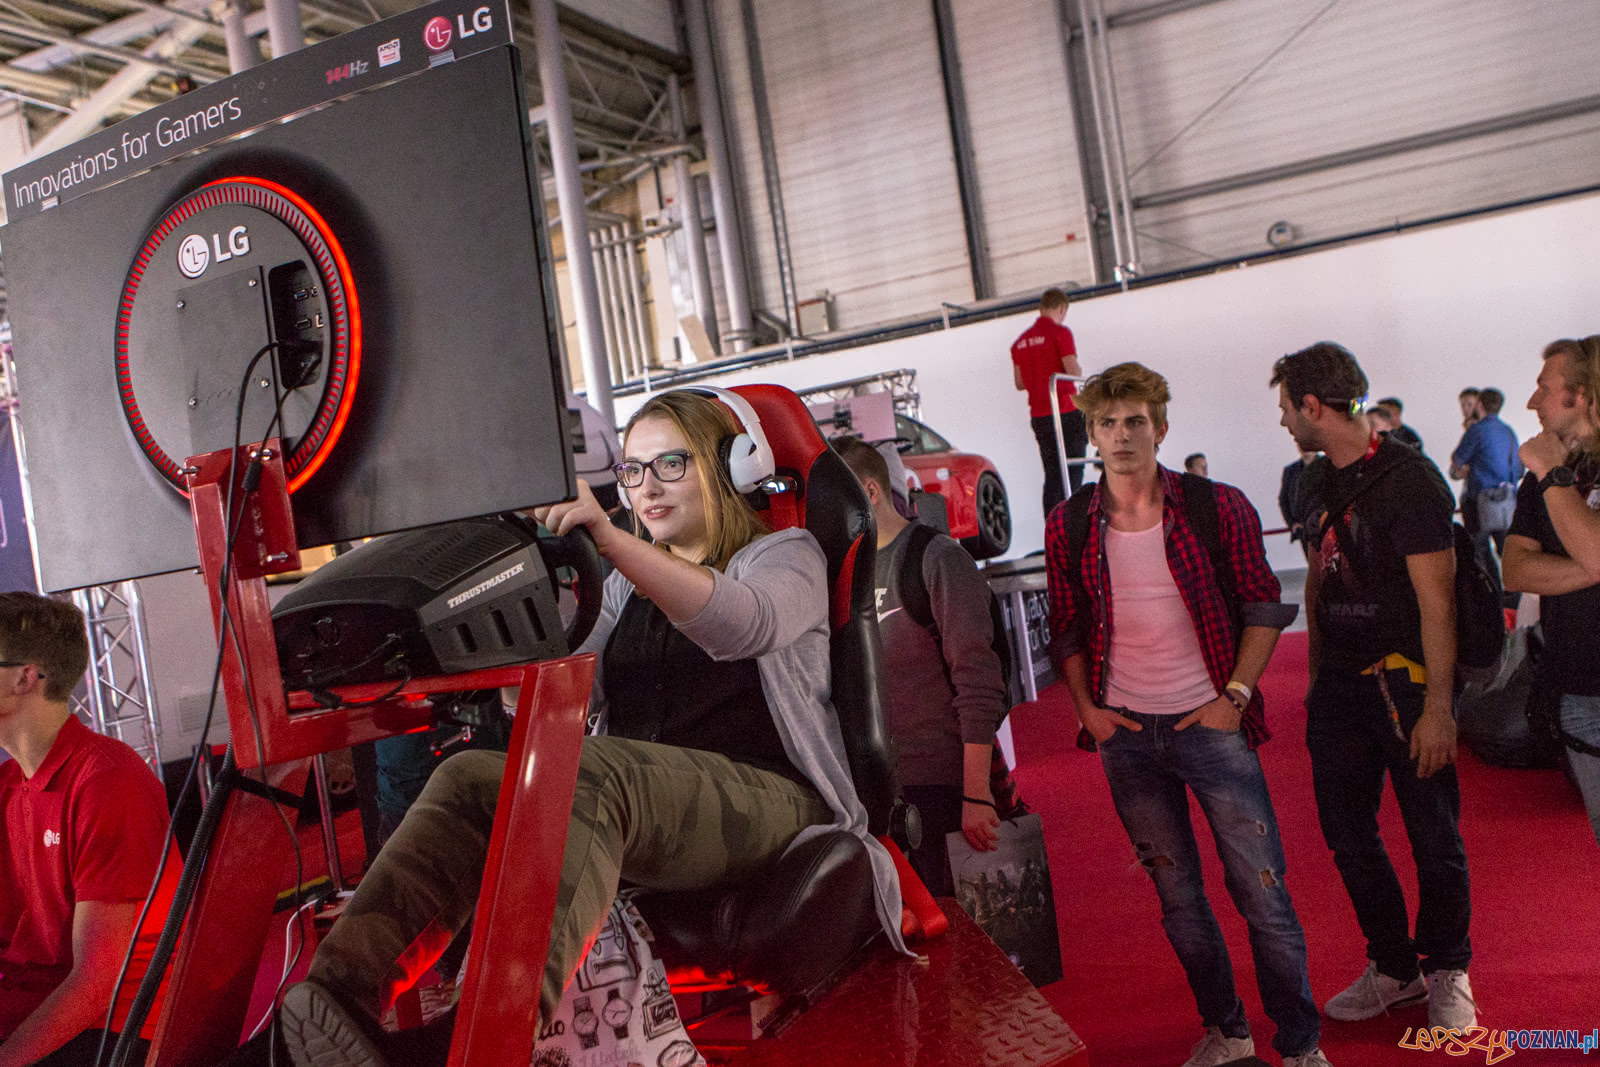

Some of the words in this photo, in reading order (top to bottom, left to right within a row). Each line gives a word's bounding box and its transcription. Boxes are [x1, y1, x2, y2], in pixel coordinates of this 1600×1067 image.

[457, 6, 493, 39] LG
[13, 147, 119, 208] Innovations
[121, 132, 151, 163] for
[155, 97, 242, 148] Gamers
[212, 225, 250, 263] LG
[447, 562, 524, 609] THRUSTMASTER
[52, 832, 61, 845] LG
